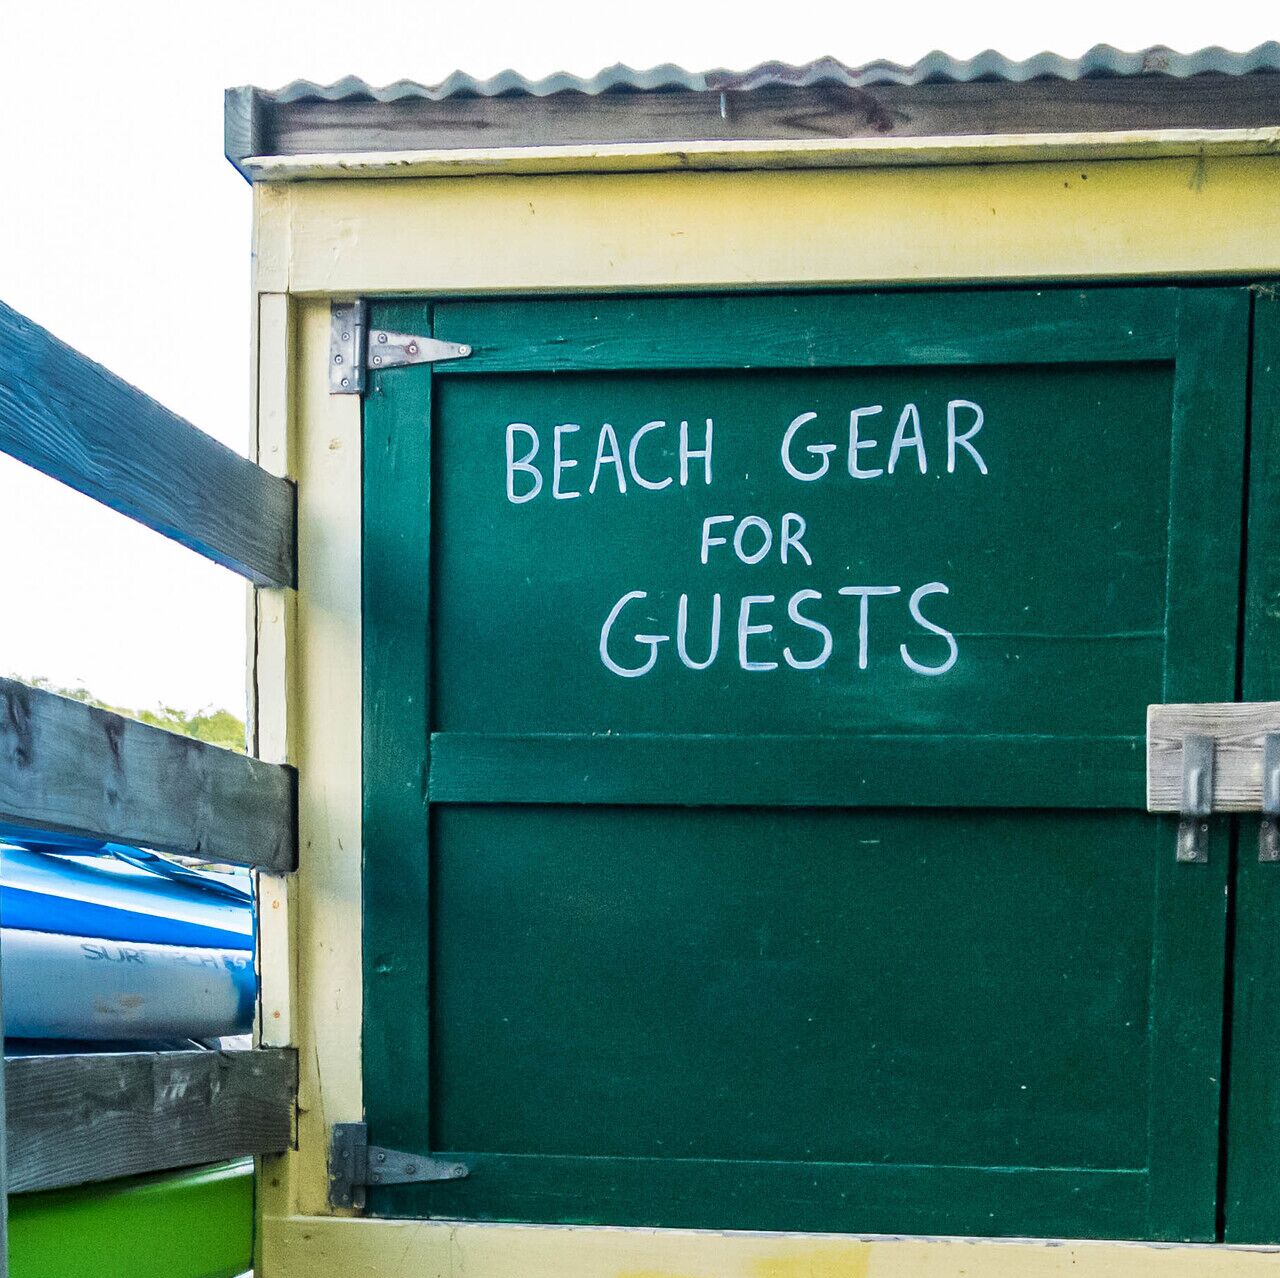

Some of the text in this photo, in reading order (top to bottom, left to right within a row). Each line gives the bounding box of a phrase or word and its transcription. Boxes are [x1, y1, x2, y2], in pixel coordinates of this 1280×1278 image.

[505, 399, 988, 503] BEACH GEAR
[700, 512, 813, 565] FOR
[599, 581, 959, 678] GUESTS
